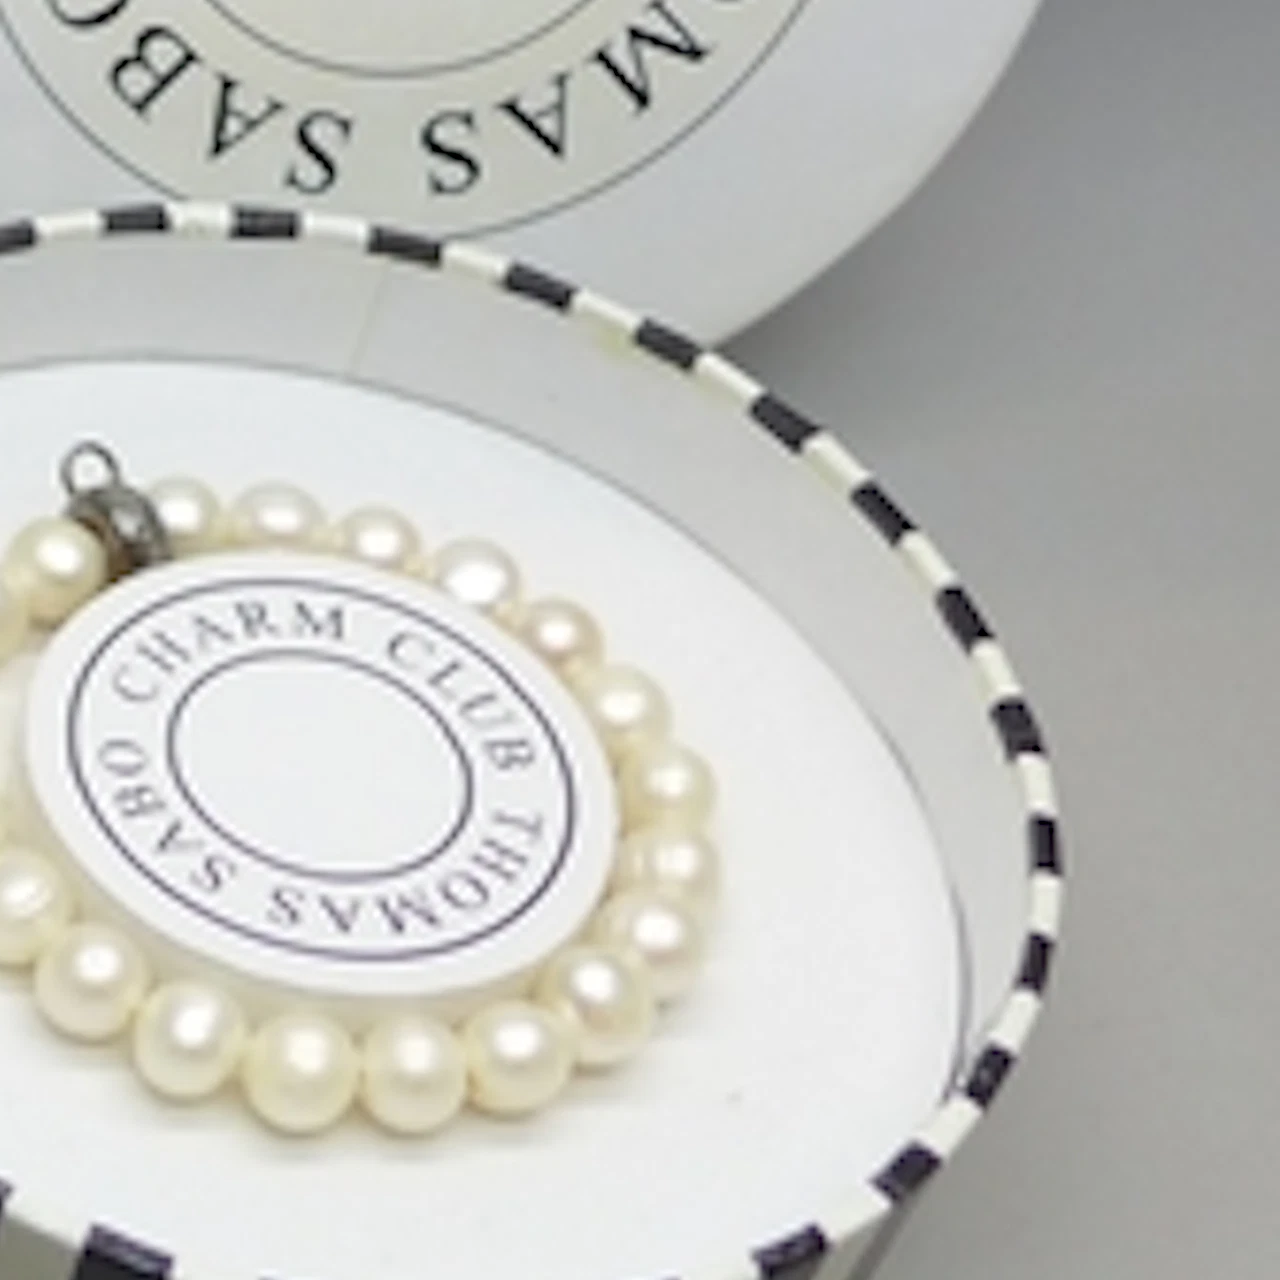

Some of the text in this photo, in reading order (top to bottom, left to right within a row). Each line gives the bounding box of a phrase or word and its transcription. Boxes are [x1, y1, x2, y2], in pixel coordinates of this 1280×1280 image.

[96, 600, 545, 935] CHARM CLUB THOMAS SABO
